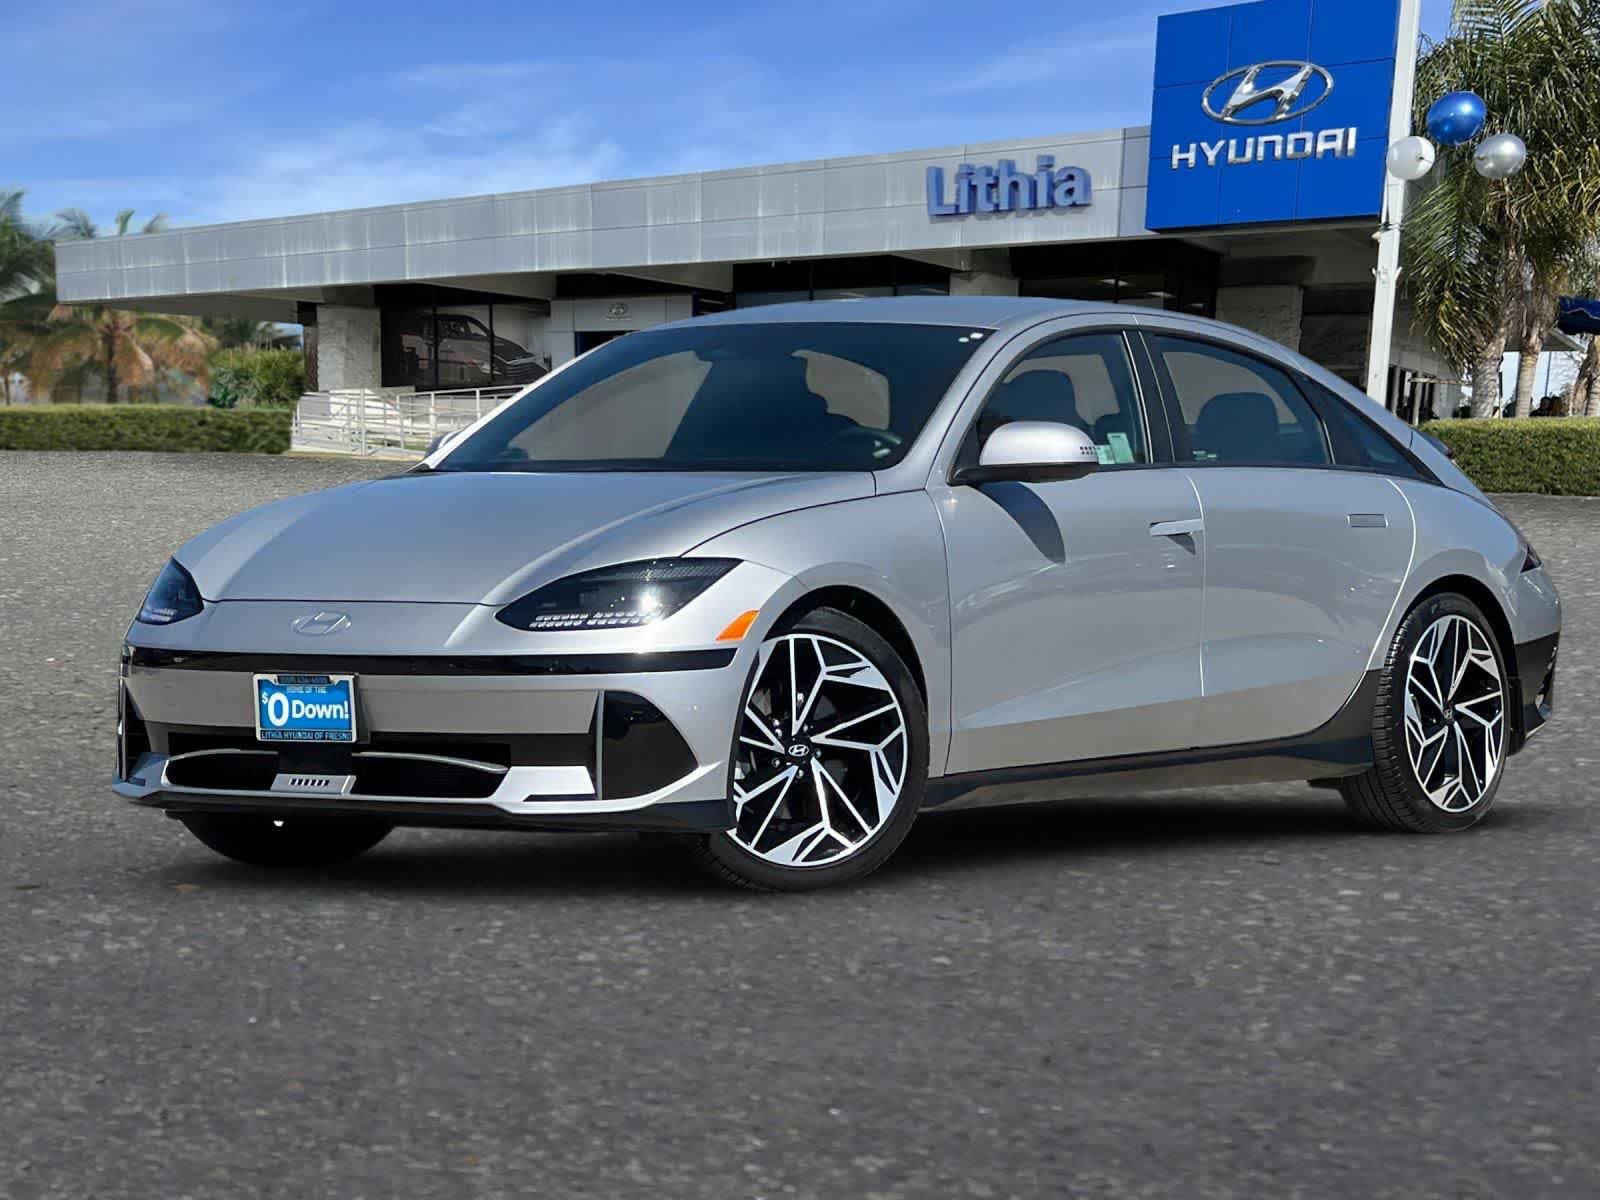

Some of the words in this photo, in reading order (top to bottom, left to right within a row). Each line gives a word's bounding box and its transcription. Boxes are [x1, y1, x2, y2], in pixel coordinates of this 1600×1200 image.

[1171, 127, 1358, 169] HYUNDAI
[926, 154, 1093, 217] Lithia
[291, 700, 349, 719] Down!
